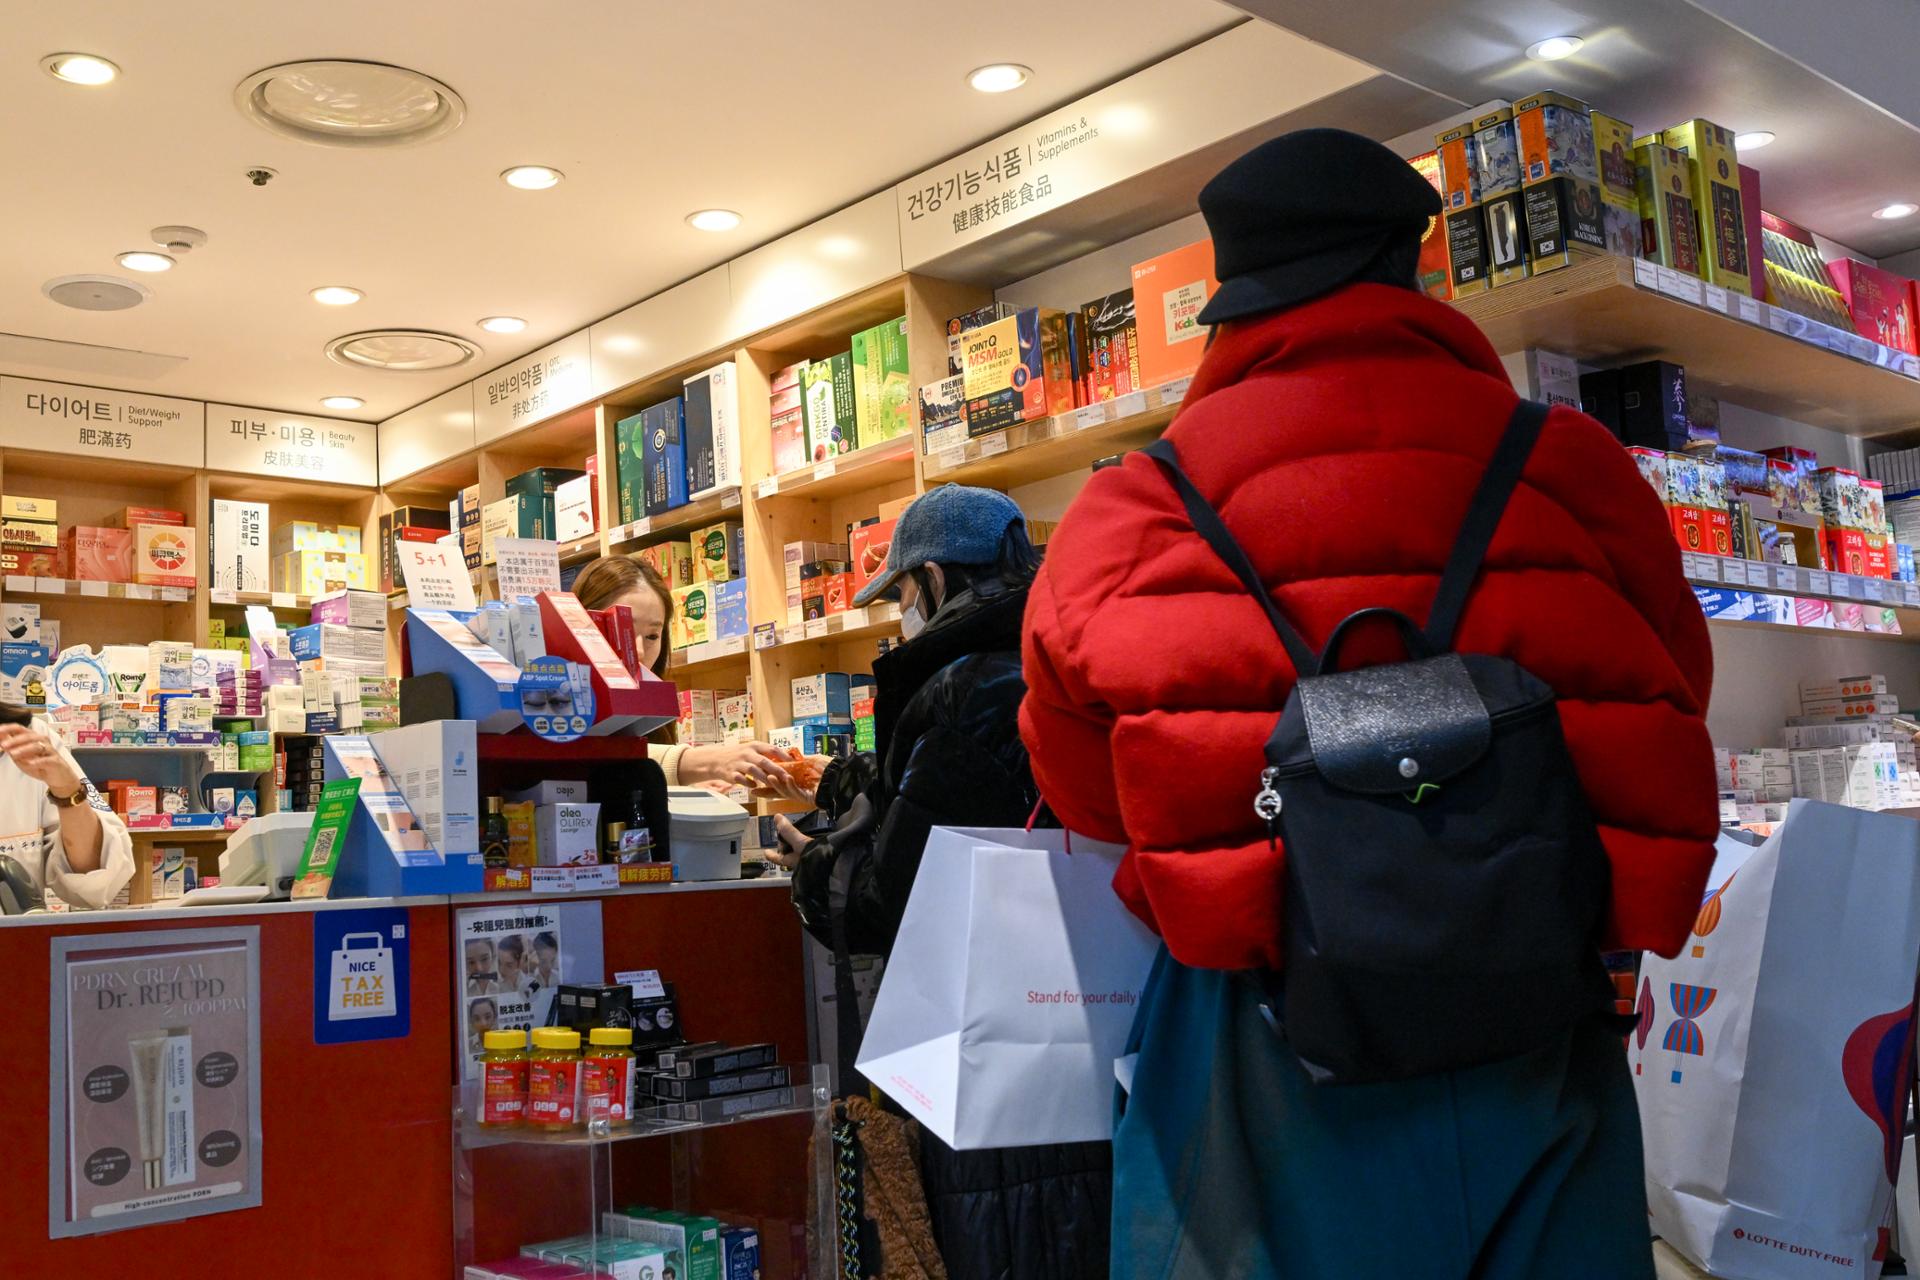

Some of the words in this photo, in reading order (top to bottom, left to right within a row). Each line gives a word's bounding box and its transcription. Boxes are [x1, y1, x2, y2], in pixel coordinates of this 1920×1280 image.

[1036, 122, 1077, 148] Vitamins
[1080, 116, 1088, 128] &
[1037, 127, 1099, 162] Supplements
[907, 147, 1022, 221] 건강기능식품
[952, 174, 1053, 235] 健康技能食品
[968, 340, 988, 355] JOINT
[988, 335, 997, 347] Q
[968, 347, 998, 369] MSM
[487, 363, 543, 406] 일반의약품
[26, 393, 113, 422] 다이어트
[128, 404, 182, 421] Diet/Weight
[128, 415, 163, 428] Support
[329, 430, 356, 443] Beauty
[329, 440, 346, 450] Skin
[414, 551, 447, 567] 5+1
[3, 647, 28, 656] omron
[62, 680, 100, 693] 아이드롭
[128, 789, 154, 797] ROHTO
[560, 807, 581, 818] olea
[349, 961, 376, 973] NICE
[73, 972, 128, 992] PDRN
[341, 974, 384, 992] TAX
[97, 989, 134, 1011] Dr.
[139, 977, 225, 1006] REJUPD
[342, 991, 384, 1008] FREE
[1027, 990, 1061, 1004] Stand
[1063, 990, 1080, 1003] for
[1081, 993, 1108, 1006] your
[1109, 990, 1137, 1006] daily
[124, 1191, 191, 1210] High-concentration
[192, 1188, 213, 1199] PDRN
[1746, 1233, 1789, 1251] LOTTE
[1788, 1244, 1823, 1260] DUTY
[1822, 1253, 1855, 1267] FREE
